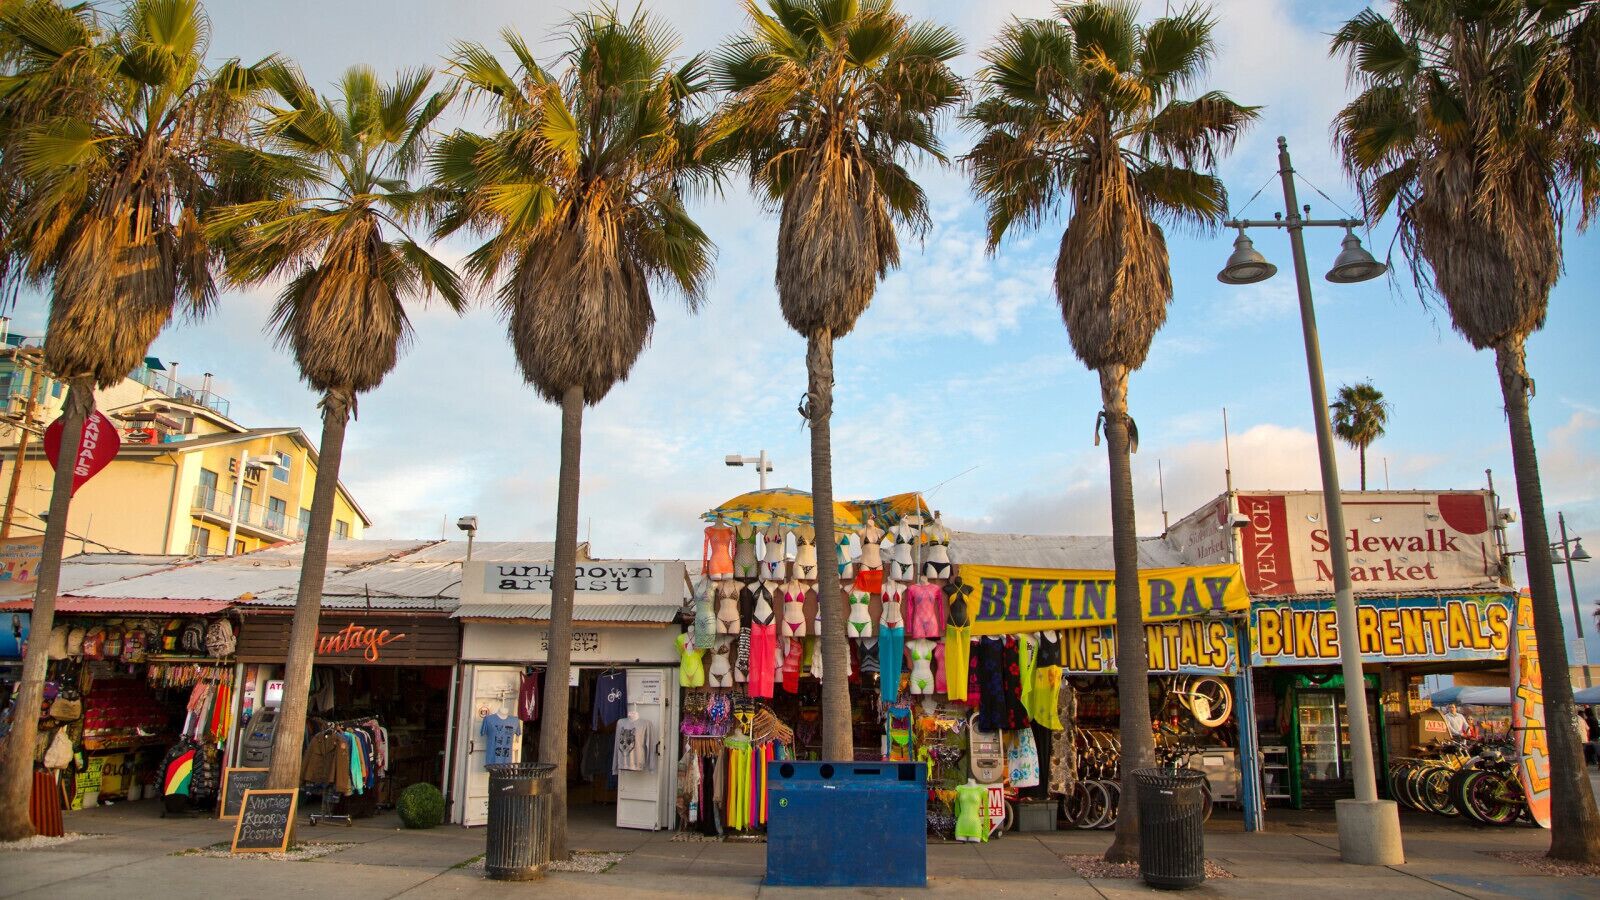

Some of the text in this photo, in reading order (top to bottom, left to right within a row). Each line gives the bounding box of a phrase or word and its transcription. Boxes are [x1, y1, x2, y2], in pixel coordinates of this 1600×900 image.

[75, 413, 100, 476] SANDALS
[1251, 500, 1278, 592] VENICE
[1310, 528, 1460, 553] Sdewalk
[975, 577, 1232, 621] BIKIN BAY
[314, 622, 406, 662] intage
[1060, 626, 1103, 671] IKE
[1113, 619, 1228, 672] NTALS
[1258, 608, 1341, 659] BIKE
[1357, 601, 1511, 659] RENTALS
